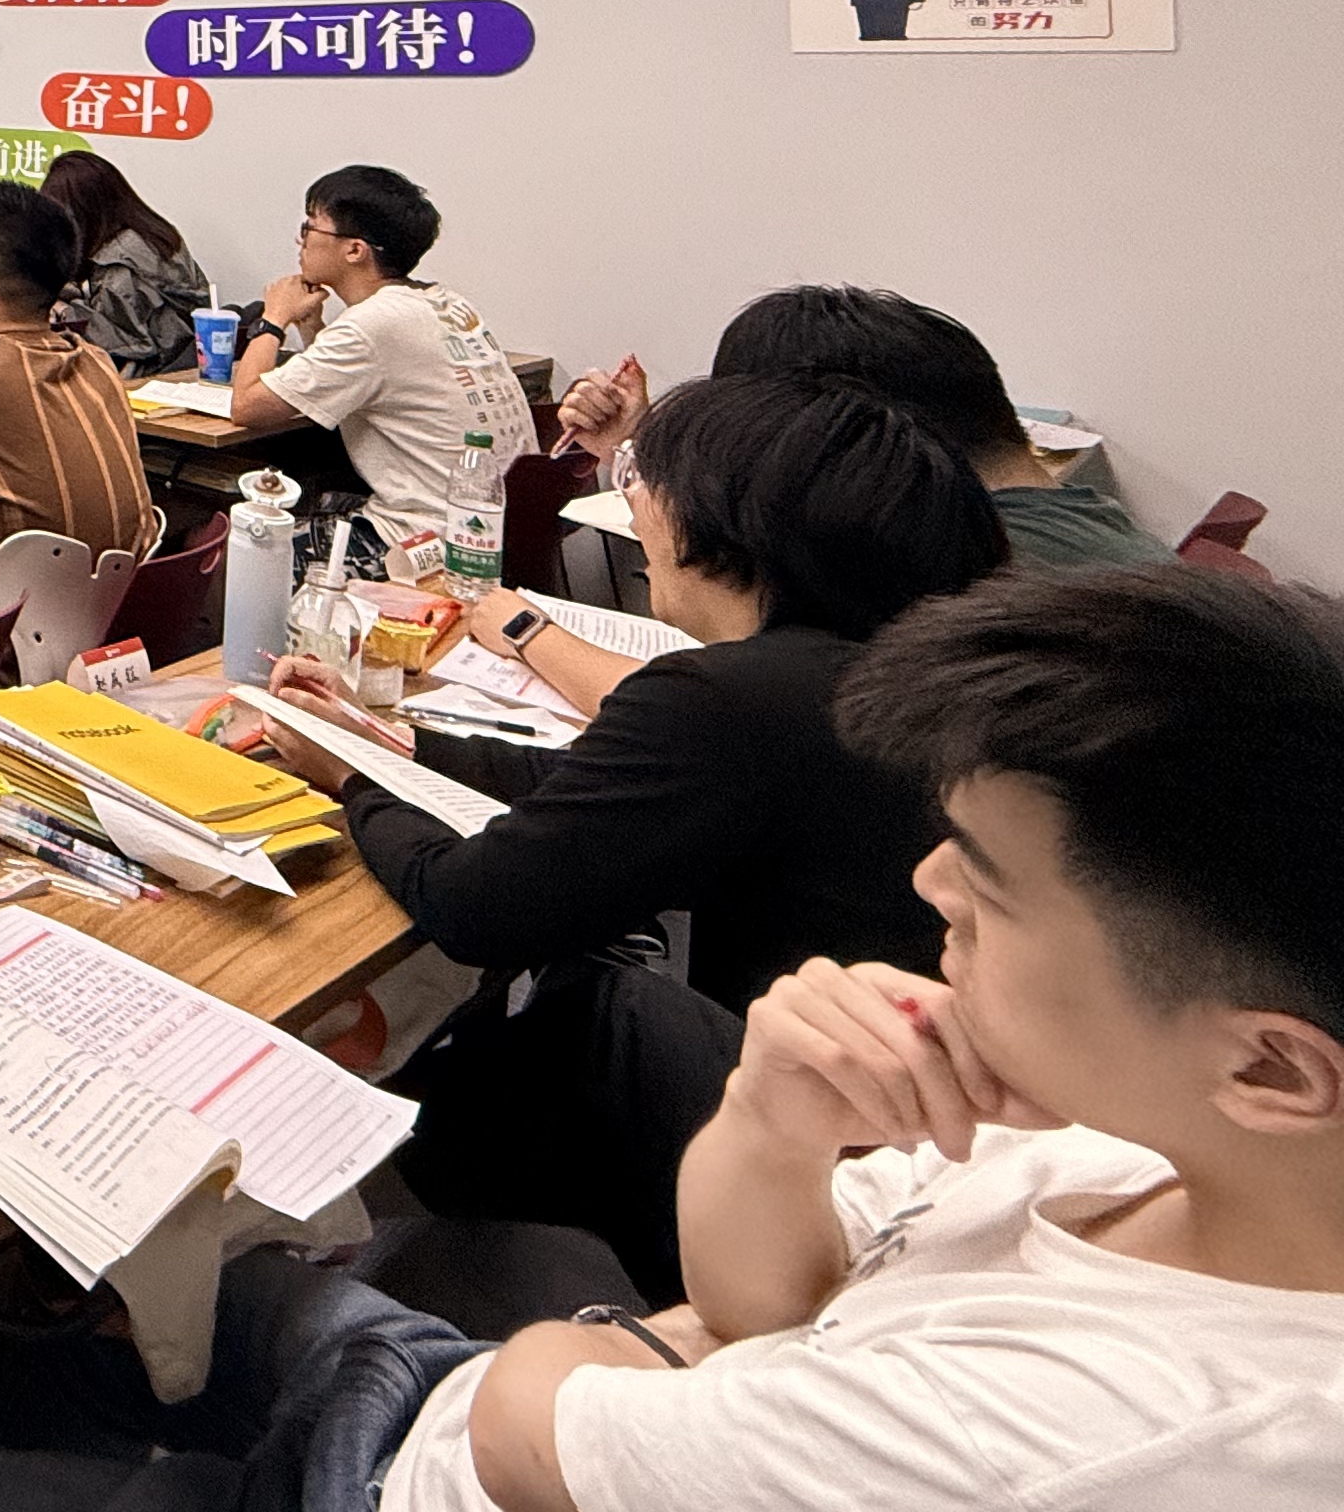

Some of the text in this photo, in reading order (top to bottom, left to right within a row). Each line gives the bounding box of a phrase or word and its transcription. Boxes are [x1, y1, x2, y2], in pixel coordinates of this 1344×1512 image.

[188, 9, 476, 71] 时不可待！
[971, 11, 1053, 31] 的努力
[60, 78, 190, 134] 奋斗！
